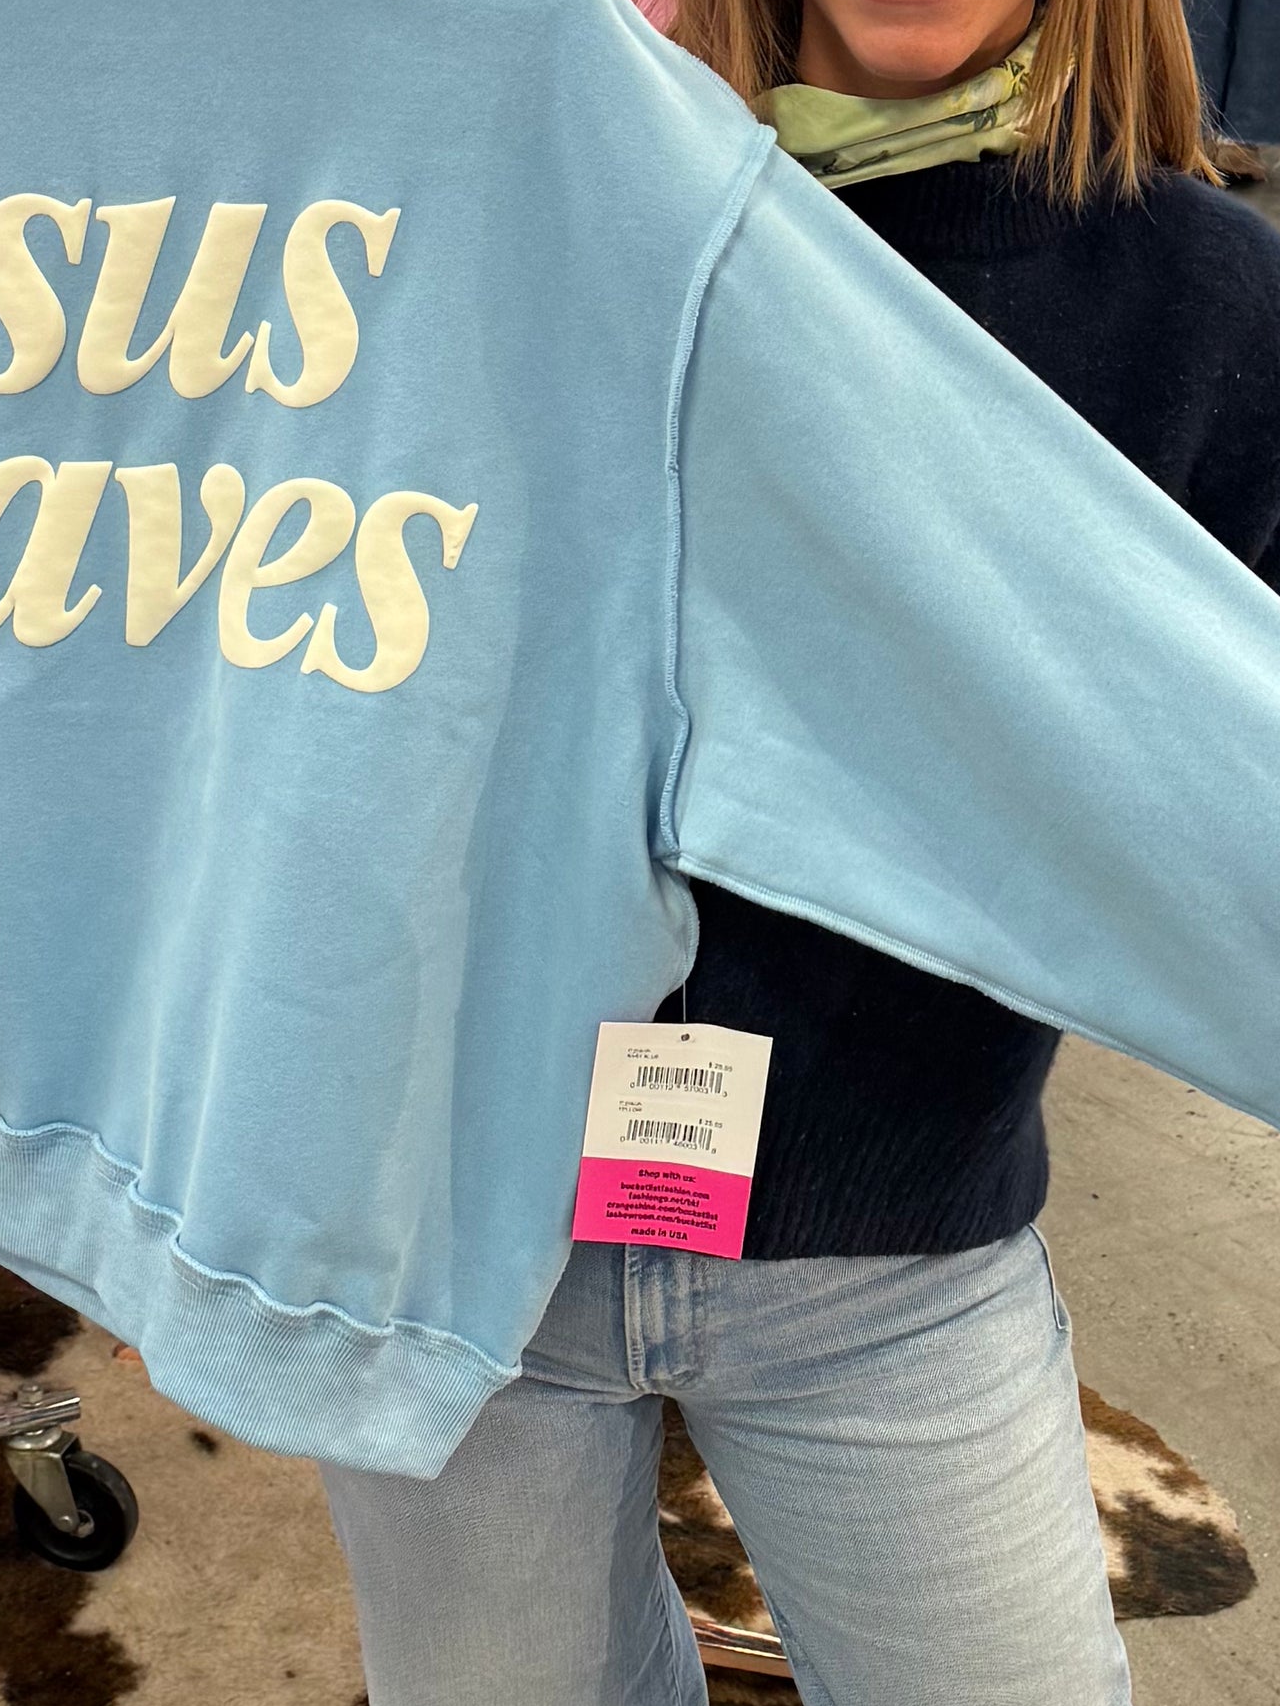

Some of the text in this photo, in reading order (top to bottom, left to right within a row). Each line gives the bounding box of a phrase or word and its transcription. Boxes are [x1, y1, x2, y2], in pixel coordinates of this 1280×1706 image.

[638, 1169, 660, 1179] Shop
[663, 1171, 681, 1180] with
[631, 1227, 655, 1236] made
[669, 1230, 688, 1240] USA
